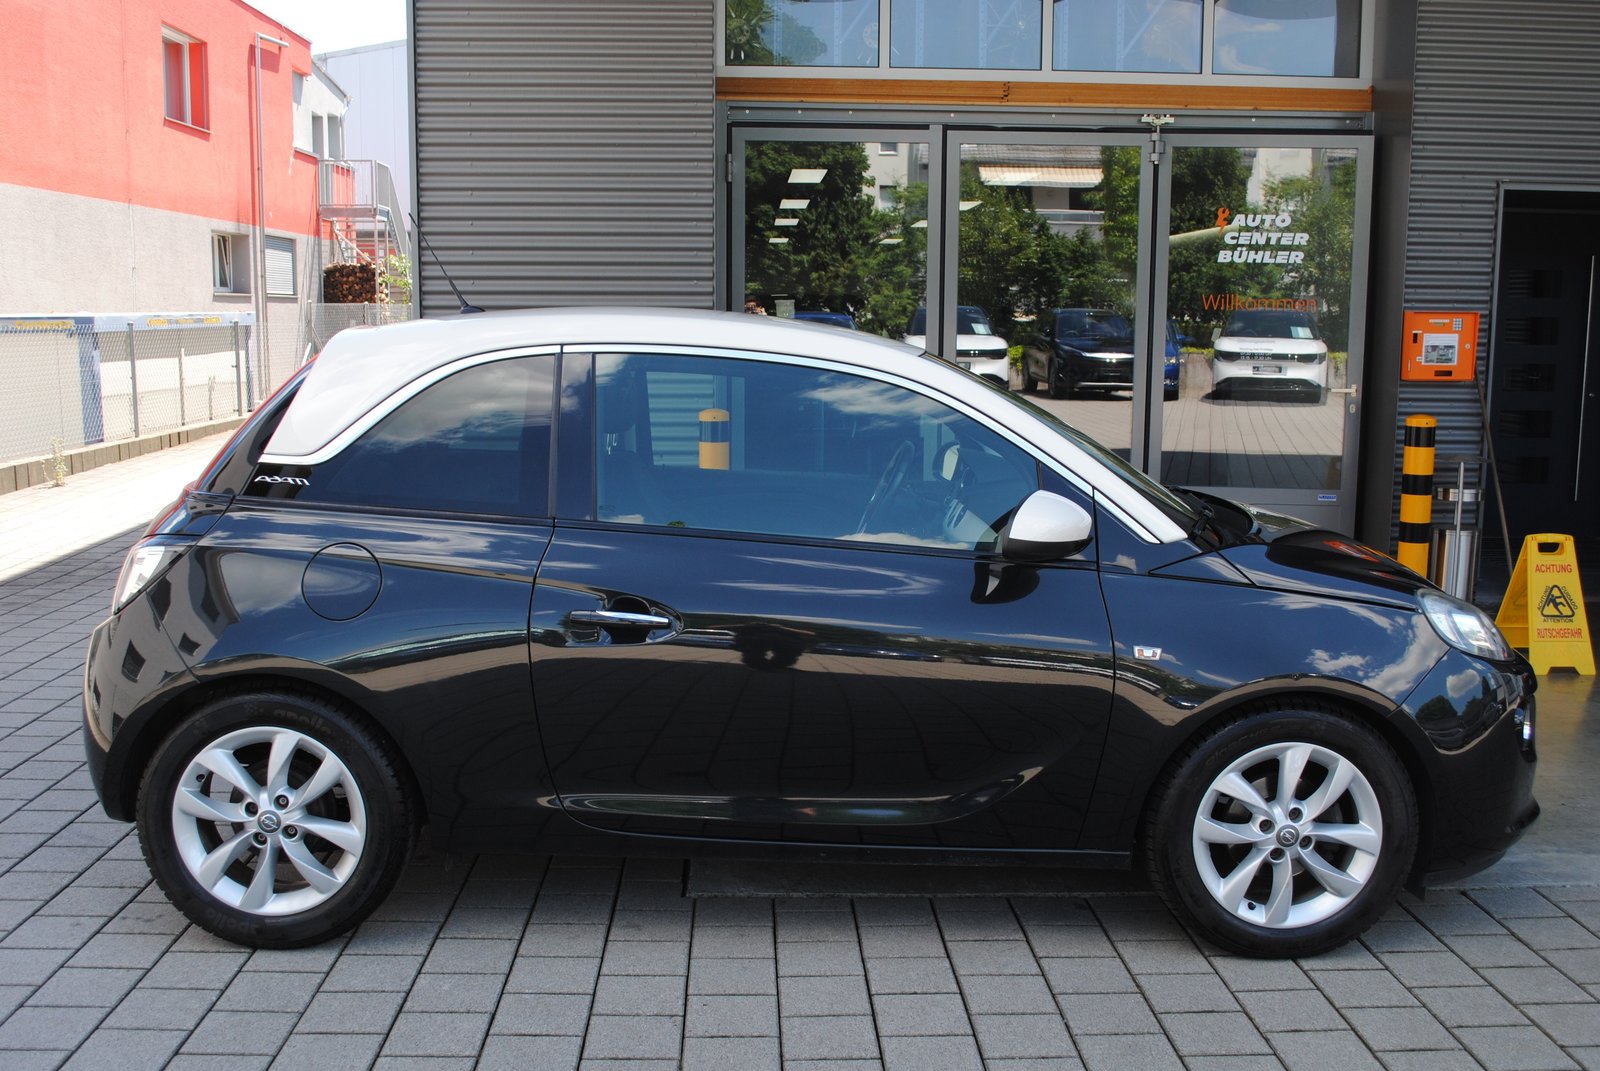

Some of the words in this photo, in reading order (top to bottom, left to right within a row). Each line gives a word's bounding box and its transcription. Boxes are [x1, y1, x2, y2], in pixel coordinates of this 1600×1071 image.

[1230, 213, 1292, 228] AUTO
[1223, 231, 1310, 246] CENTER
[1217, 247, 1305, 263] BÜHLER
[1201, 292, 1317, 313] Willkommen
[1535, 564, 1572, 573] ACHTUNG
[1537, 628, 1582, 639] RUTSCHGEFAHR
